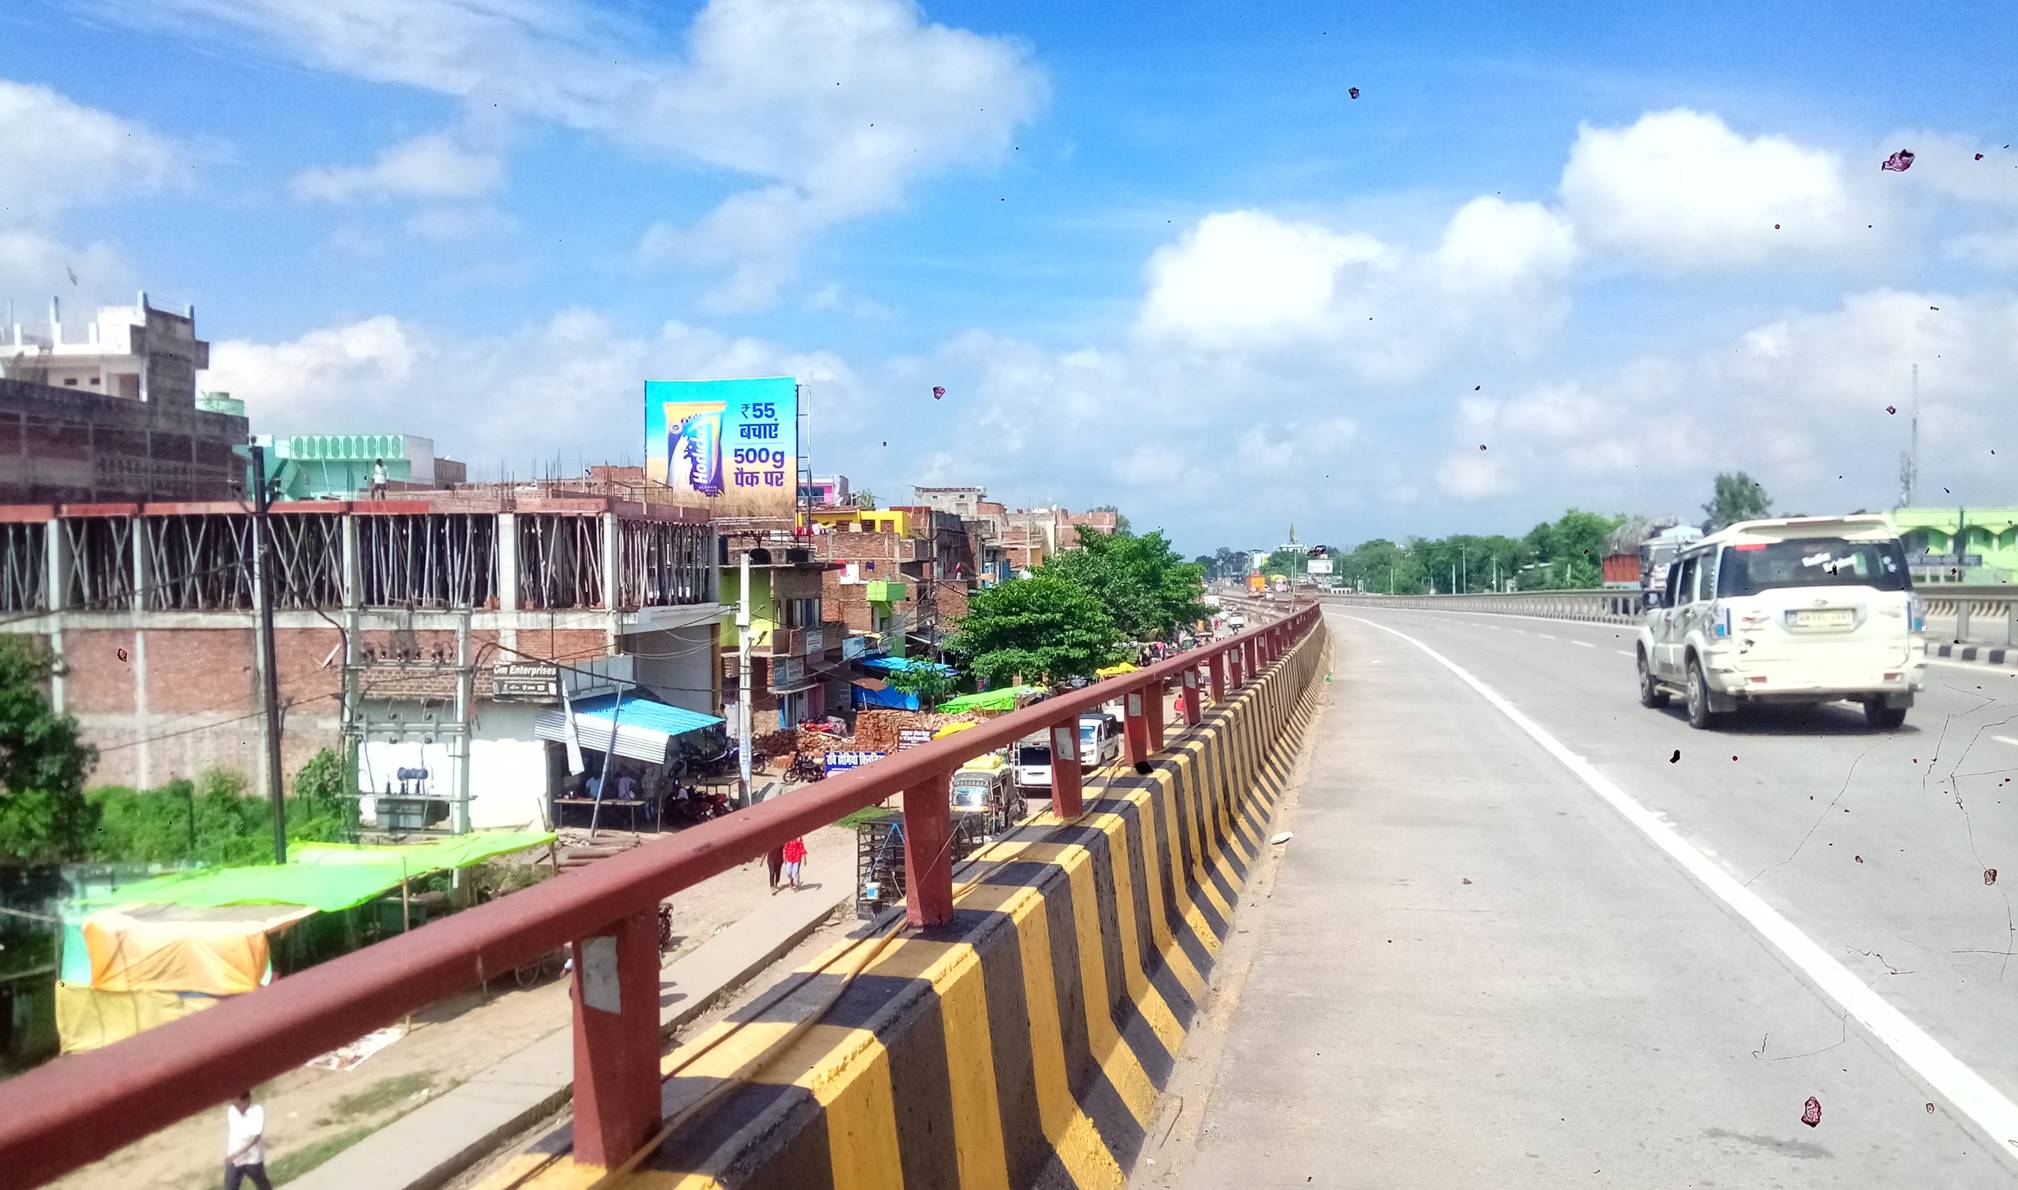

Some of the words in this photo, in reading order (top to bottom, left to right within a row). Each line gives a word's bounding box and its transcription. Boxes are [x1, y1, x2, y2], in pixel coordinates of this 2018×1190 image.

[734, 467, 760, 487] पैक
[763, 470, 785, 487] पर
[509, 665, 557, 676] Enterprises
